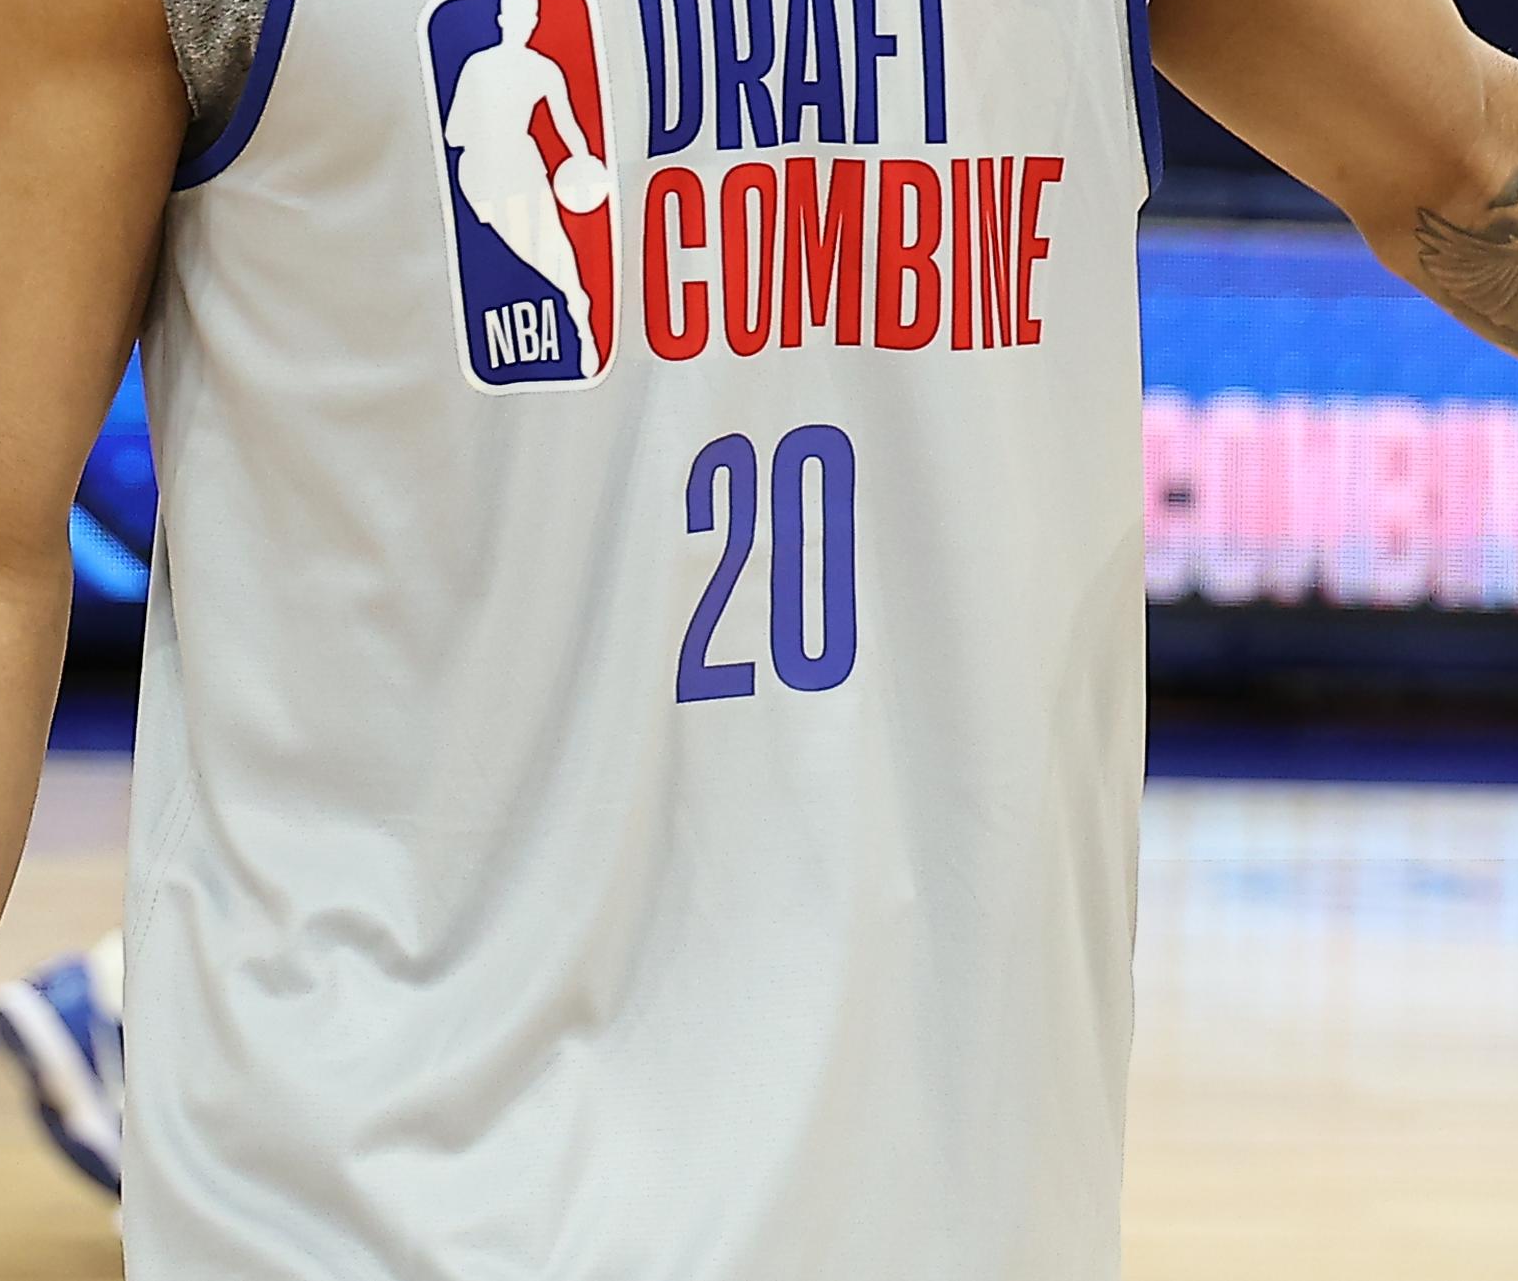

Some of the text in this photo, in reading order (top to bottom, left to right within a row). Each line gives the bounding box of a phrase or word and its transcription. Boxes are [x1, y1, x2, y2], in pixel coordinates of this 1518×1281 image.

[484, 297, 562, 369] NBA
[640, 156, 1065, 362] COMBINE
[675, 424, 856, 704] 20
